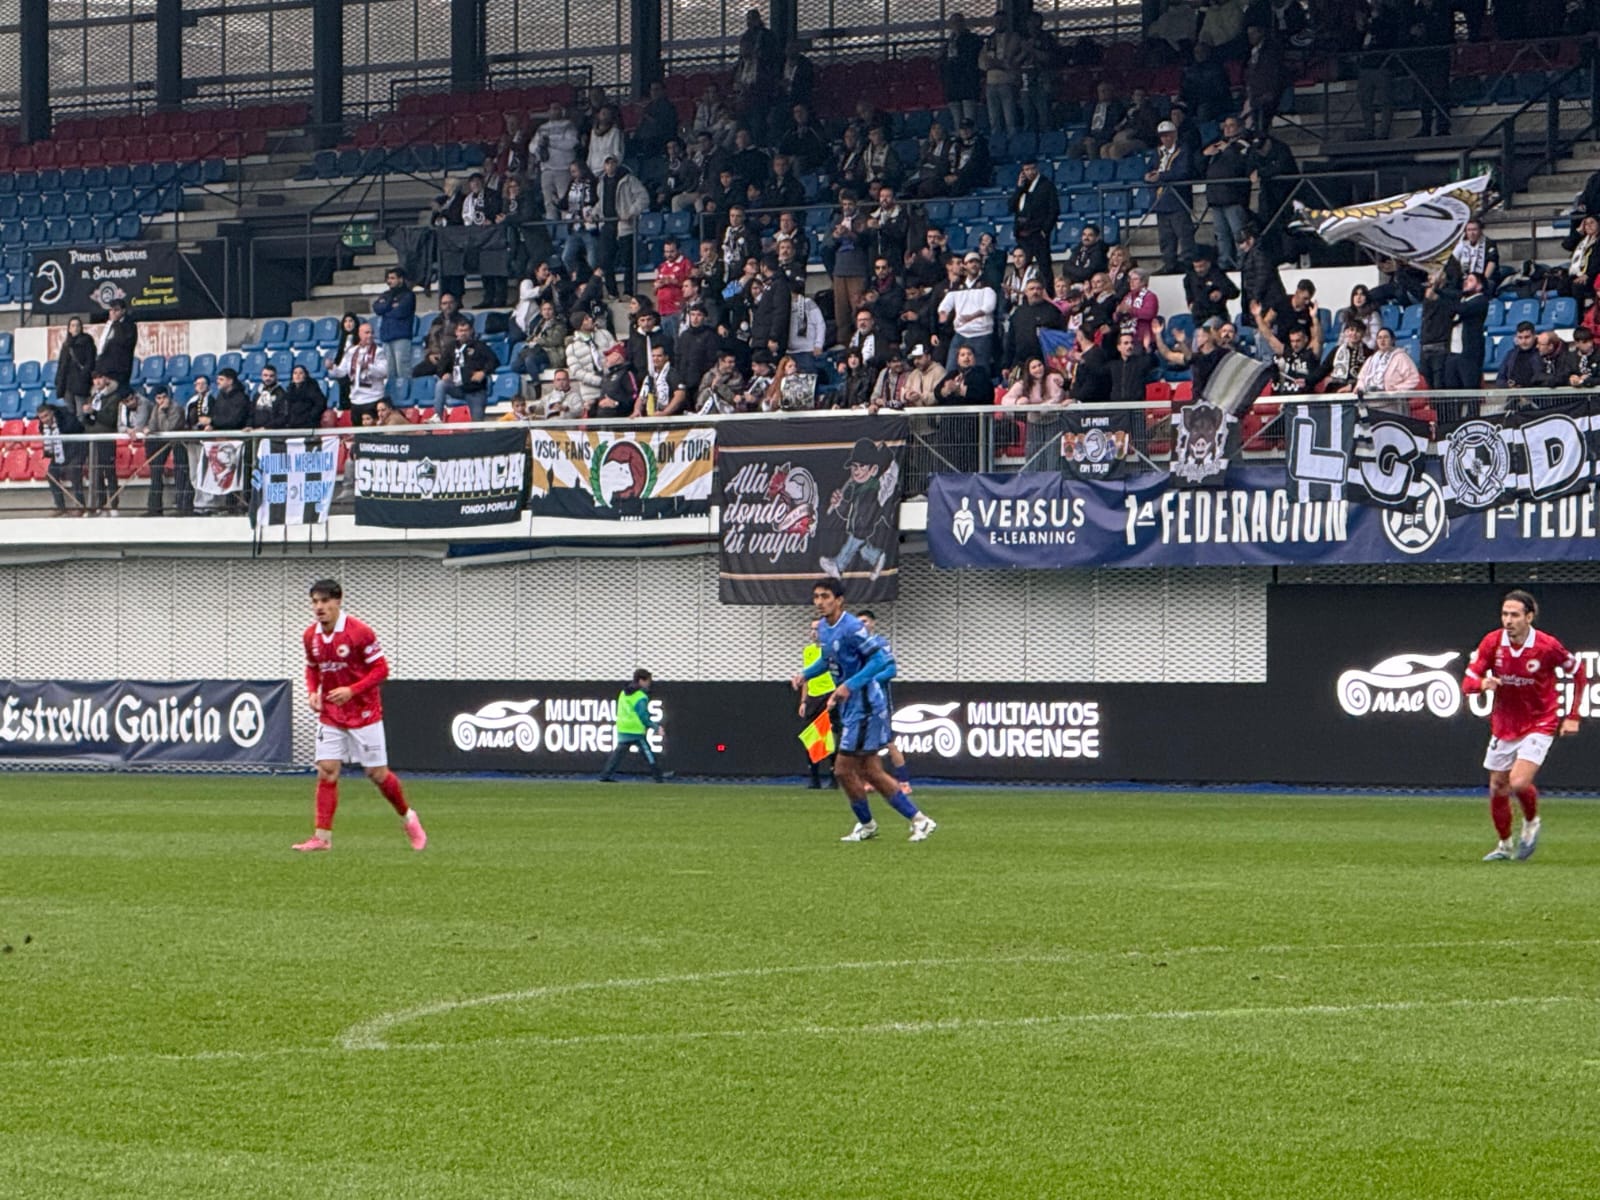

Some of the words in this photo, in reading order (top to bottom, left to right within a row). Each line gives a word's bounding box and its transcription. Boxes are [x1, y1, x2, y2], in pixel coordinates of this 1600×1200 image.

[565, 440, 591, 461] FANS
[681, 439, 712, 462] TOUR
[723, 462, 769, 494] Allá
[460, 503, 486, 515] FONDO
[723, 493, 788, 524] donde
[977, 497, 1086, 528] VERSUS
[748, 532, 810, 564] vayas
[990, 532, 1076, 545] E-LEARNING
[0, 694, 111, 743] Estrella
[114, 694, 222, 744] Galicia
[967, 702, 1100, 726] MULTIAUTOS
[967, 728, 1100, 759] OURENSE
